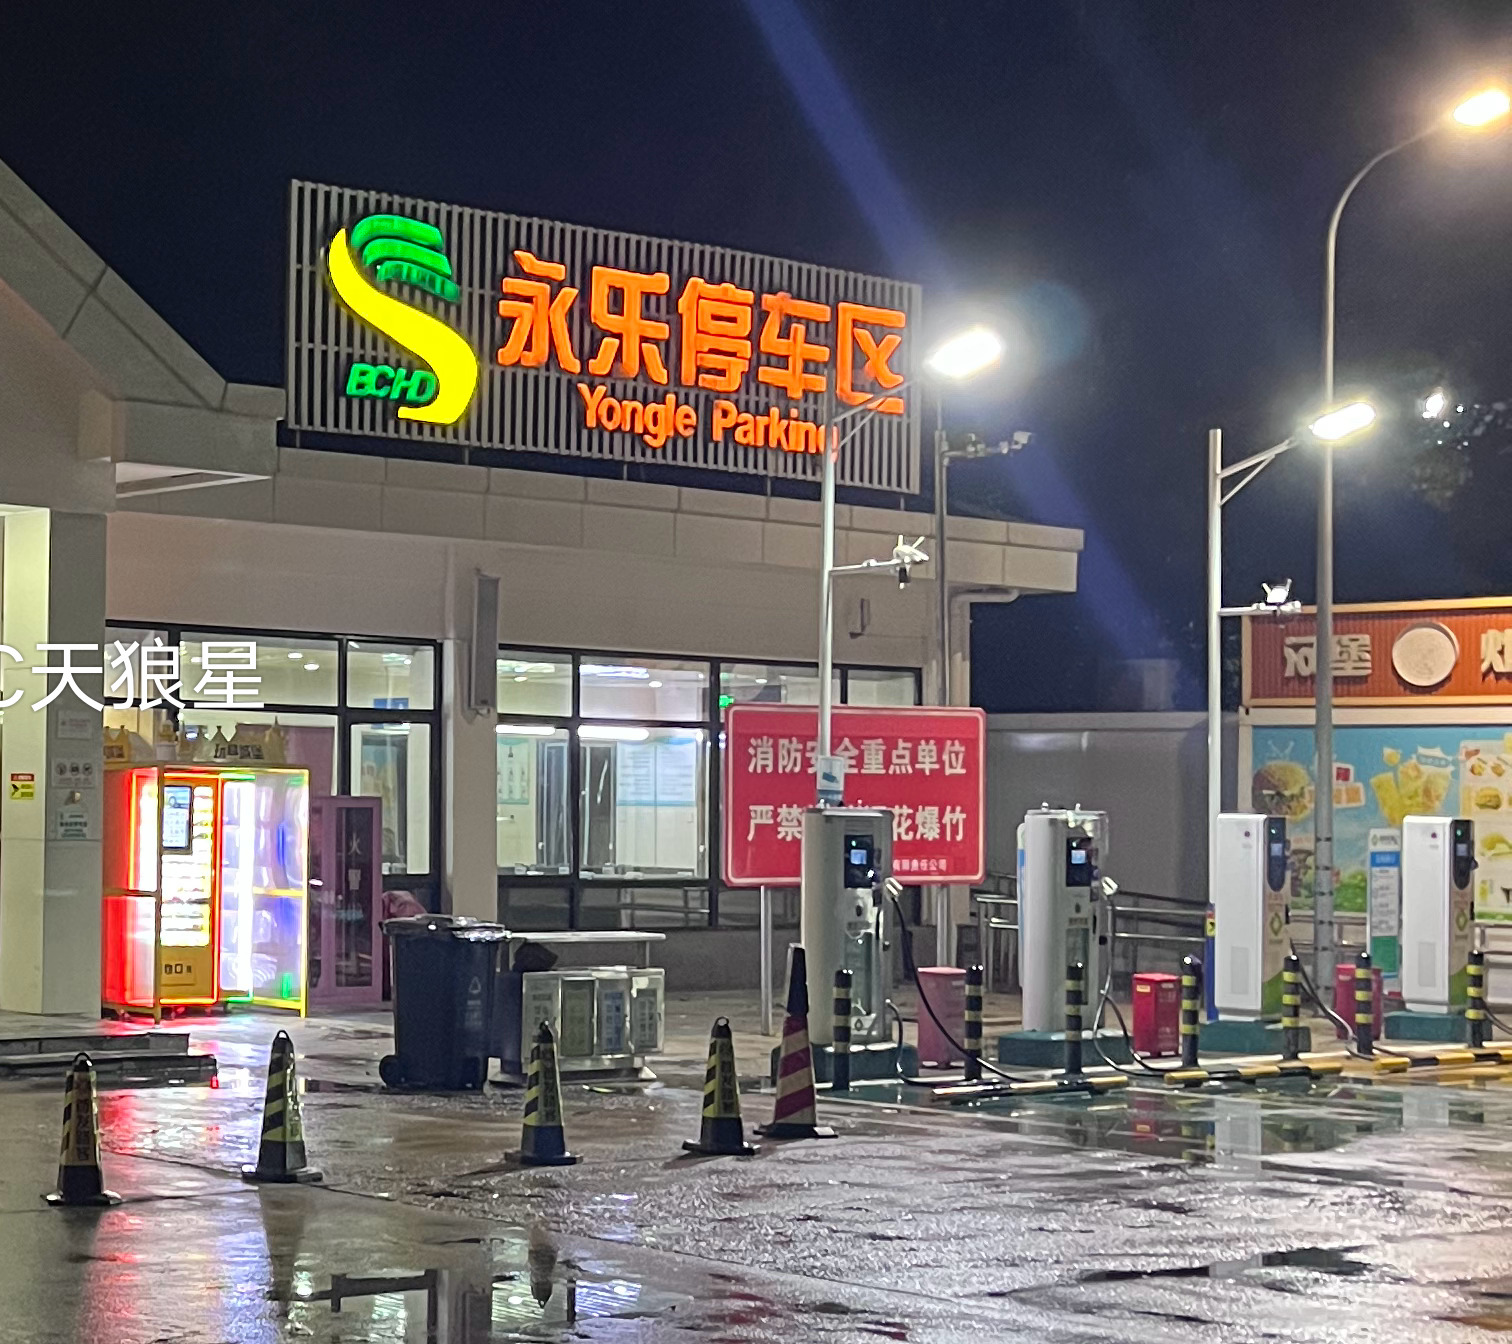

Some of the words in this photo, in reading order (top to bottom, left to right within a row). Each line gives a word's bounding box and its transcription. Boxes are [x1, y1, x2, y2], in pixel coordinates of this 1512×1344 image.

[497, 249, 906, 415] 永乐停车区
[346, 362, 438, 403] BCHD
[577, 382, 698, 449] Yongle
[712, 399, 839, 464] Parking
[746, 803, 967, 842] 严禁花爆竹
